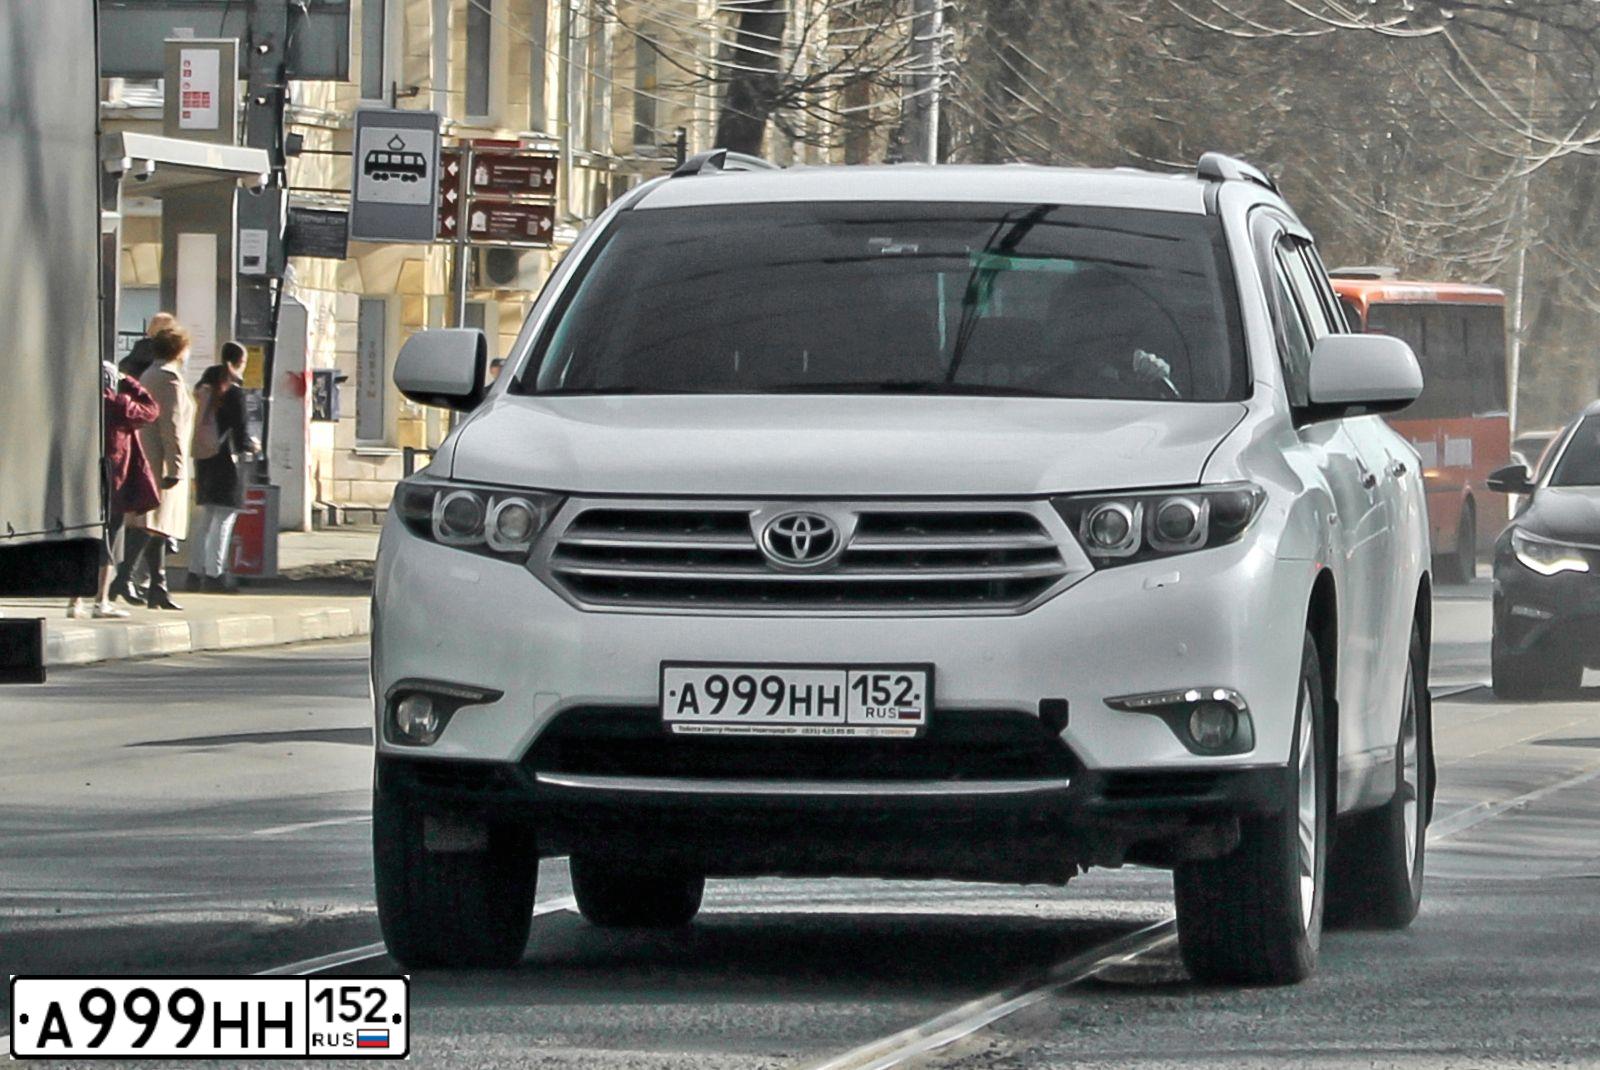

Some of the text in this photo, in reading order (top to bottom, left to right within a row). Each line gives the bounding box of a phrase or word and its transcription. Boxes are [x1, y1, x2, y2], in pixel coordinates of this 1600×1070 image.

[677, 674, 913, 717] А999НН 152
[865, 707, 897, 719] RUS
